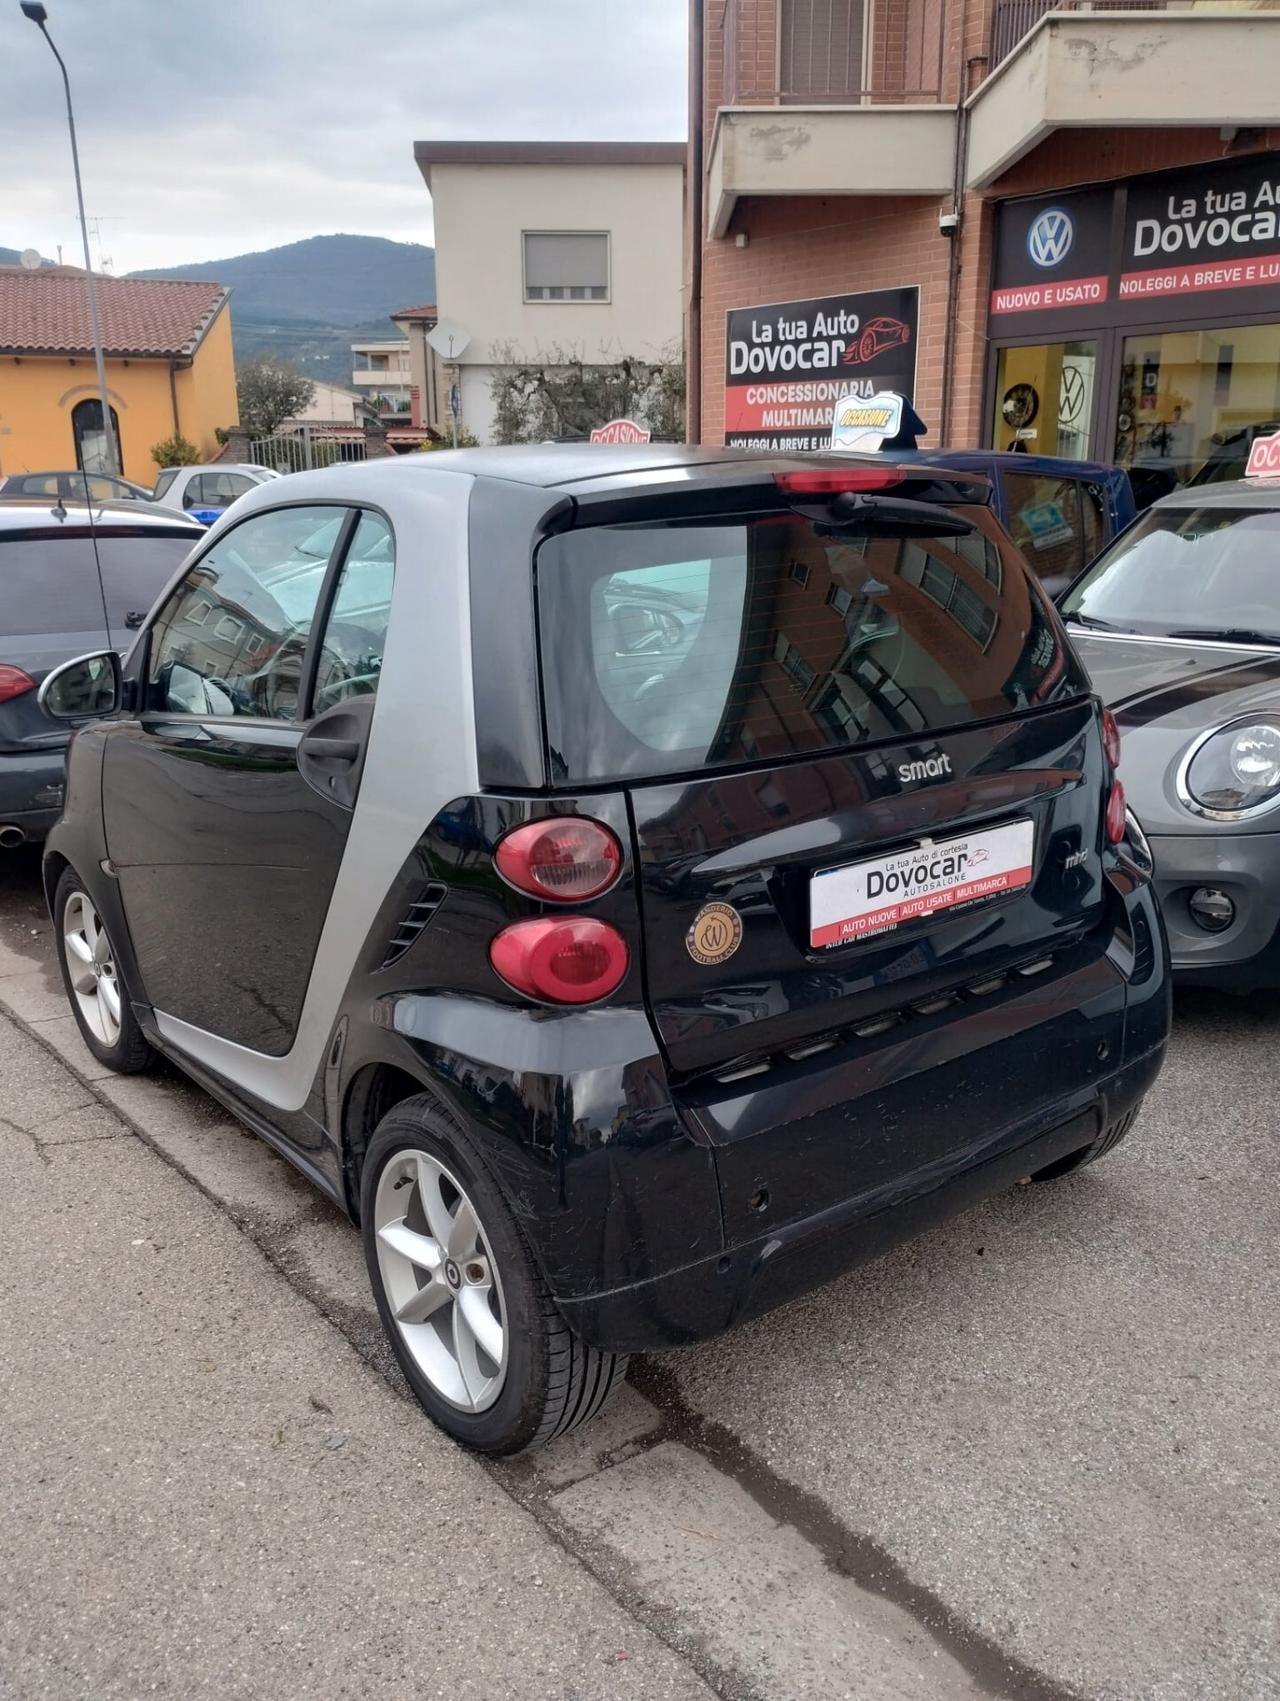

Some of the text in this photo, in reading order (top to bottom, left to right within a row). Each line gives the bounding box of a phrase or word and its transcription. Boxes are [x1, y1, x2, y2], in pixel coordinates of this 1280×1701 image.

[1167, 195, 1197, 220] La
[1204, 189, 1247, 215] tua
[1133, 211, 1280, 257] Dovoca
[1119, 263, 1280, 294] NOLEGGI A BREVE E LU
[996, 283, 1101, 311] NUOVO E USATO
[752, 308, 860, 344] La tua Auto
[730, 339, 846, 376] Dovocar
[746, 379, 875, 405] CONCESSIONARIA
[761, 406, 834, 428] MULTIMAR
[840, 408, 894, 427] OCCASIONE
[779, 436, 809, 450] BREVE
[811, 437, 818, 450] E
[819, 436, 831, 450] LU
[1253, 438, 1280, 468] OC
[898, 752, 952, 783] smart
[885, 843, 969, 872] La tua Auto di cortesia
[866, 853, 968, 900] Dovocar
[903, 872, 967, 898] AUTOSALONE
[841, 918, 866, 936] AUTO
[867, 908, 898, 927] NUOVE
[902, 901, 925, 917] AUTO
[926, 892, 953, 909] USATE
[956, 876, 1008, 900] MULTIMARCA
